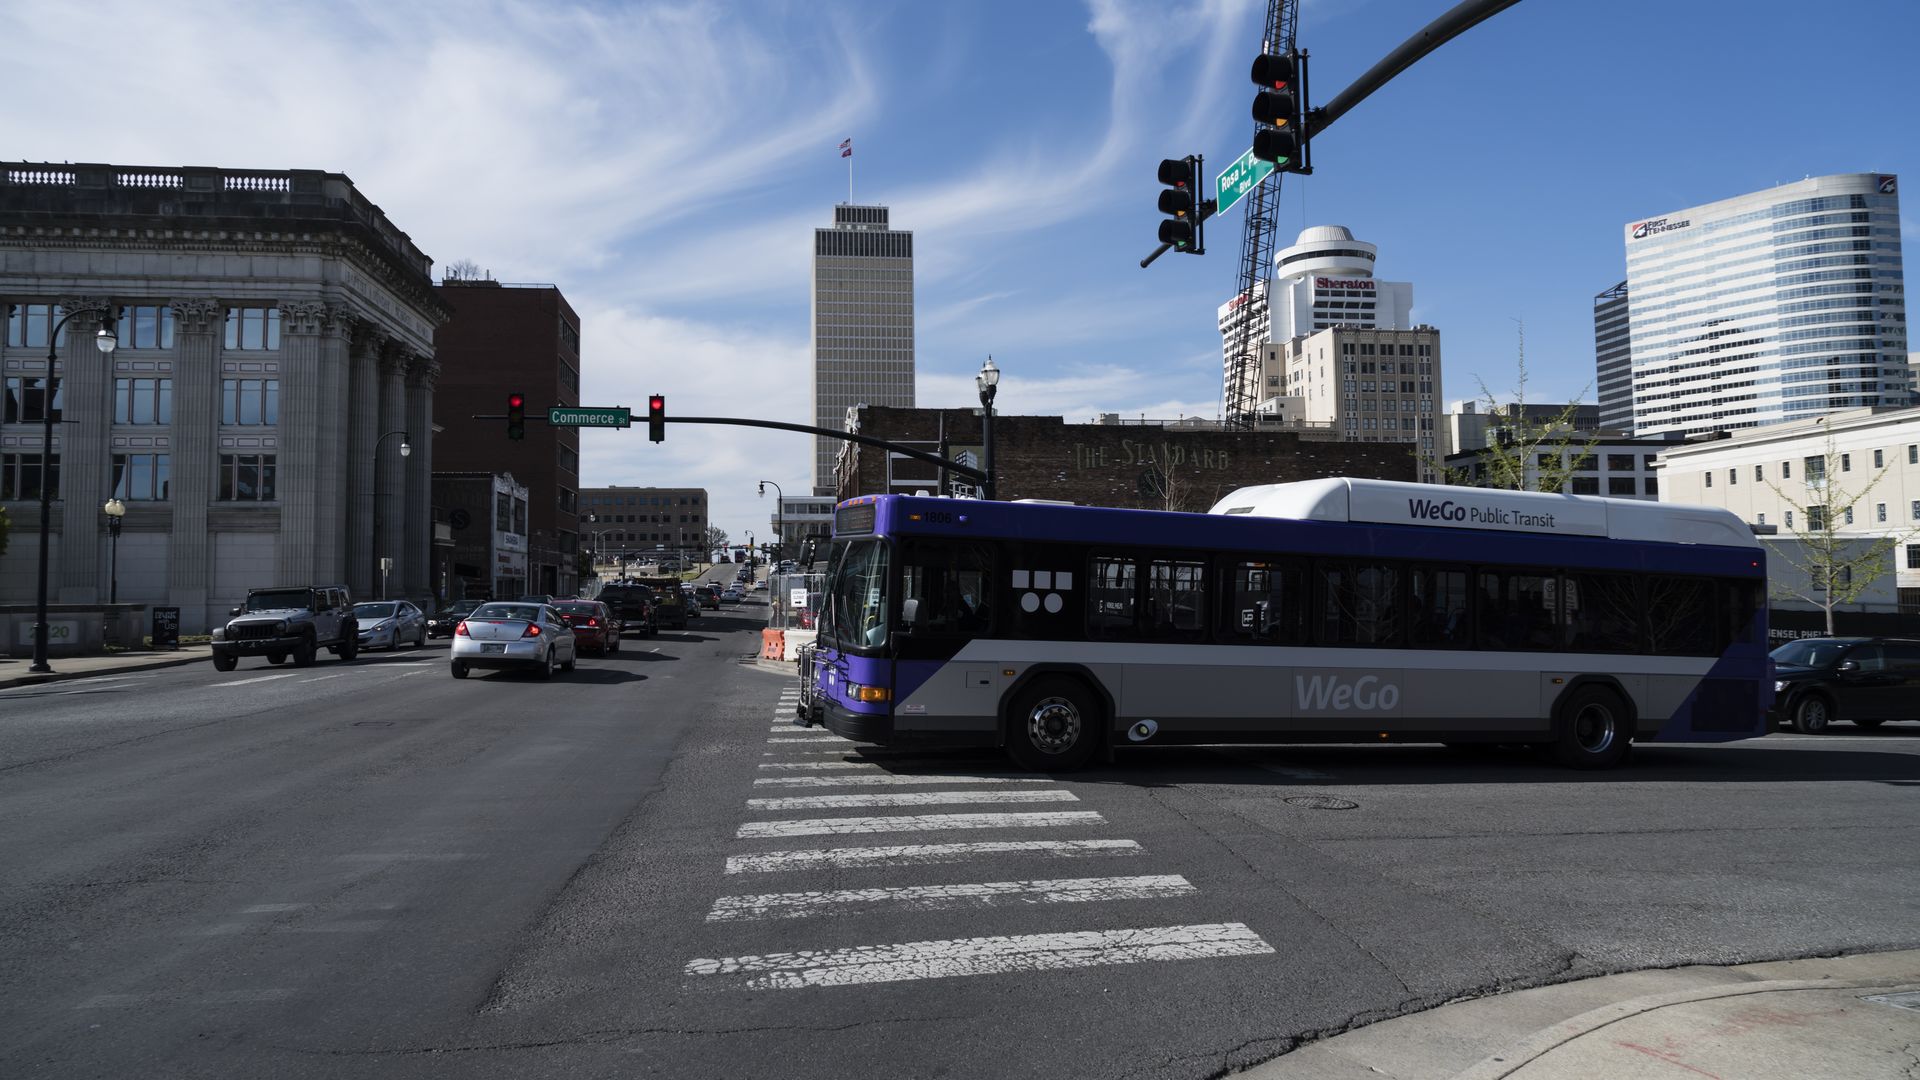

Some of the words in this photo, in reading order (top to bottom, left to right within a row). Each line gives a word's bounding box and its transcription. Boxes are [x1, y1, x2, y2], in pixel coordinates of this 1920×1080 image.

[1221, 168, 1239, 193] Rosa
[1241, 160, 1247, 177] L
[1239, 175, 1252, 194] Blvd
[1647, 220, 1690, 235] TENNESSEE
[1648, 219, 1667, 228] FIRST
[1316, 277, 1375, 290] Sheraton
[551, 411, 615, 424] Commerce
[618, 417, 626, 425] St
[925, 511, 952, 524] 1806
[1408, 498, 1466, 522] WeGo
[1470, 507, 1509, 525] Public
[1511, 510, 1555, 527] Transit
[1296, 675, 1400, 711] WeGo
